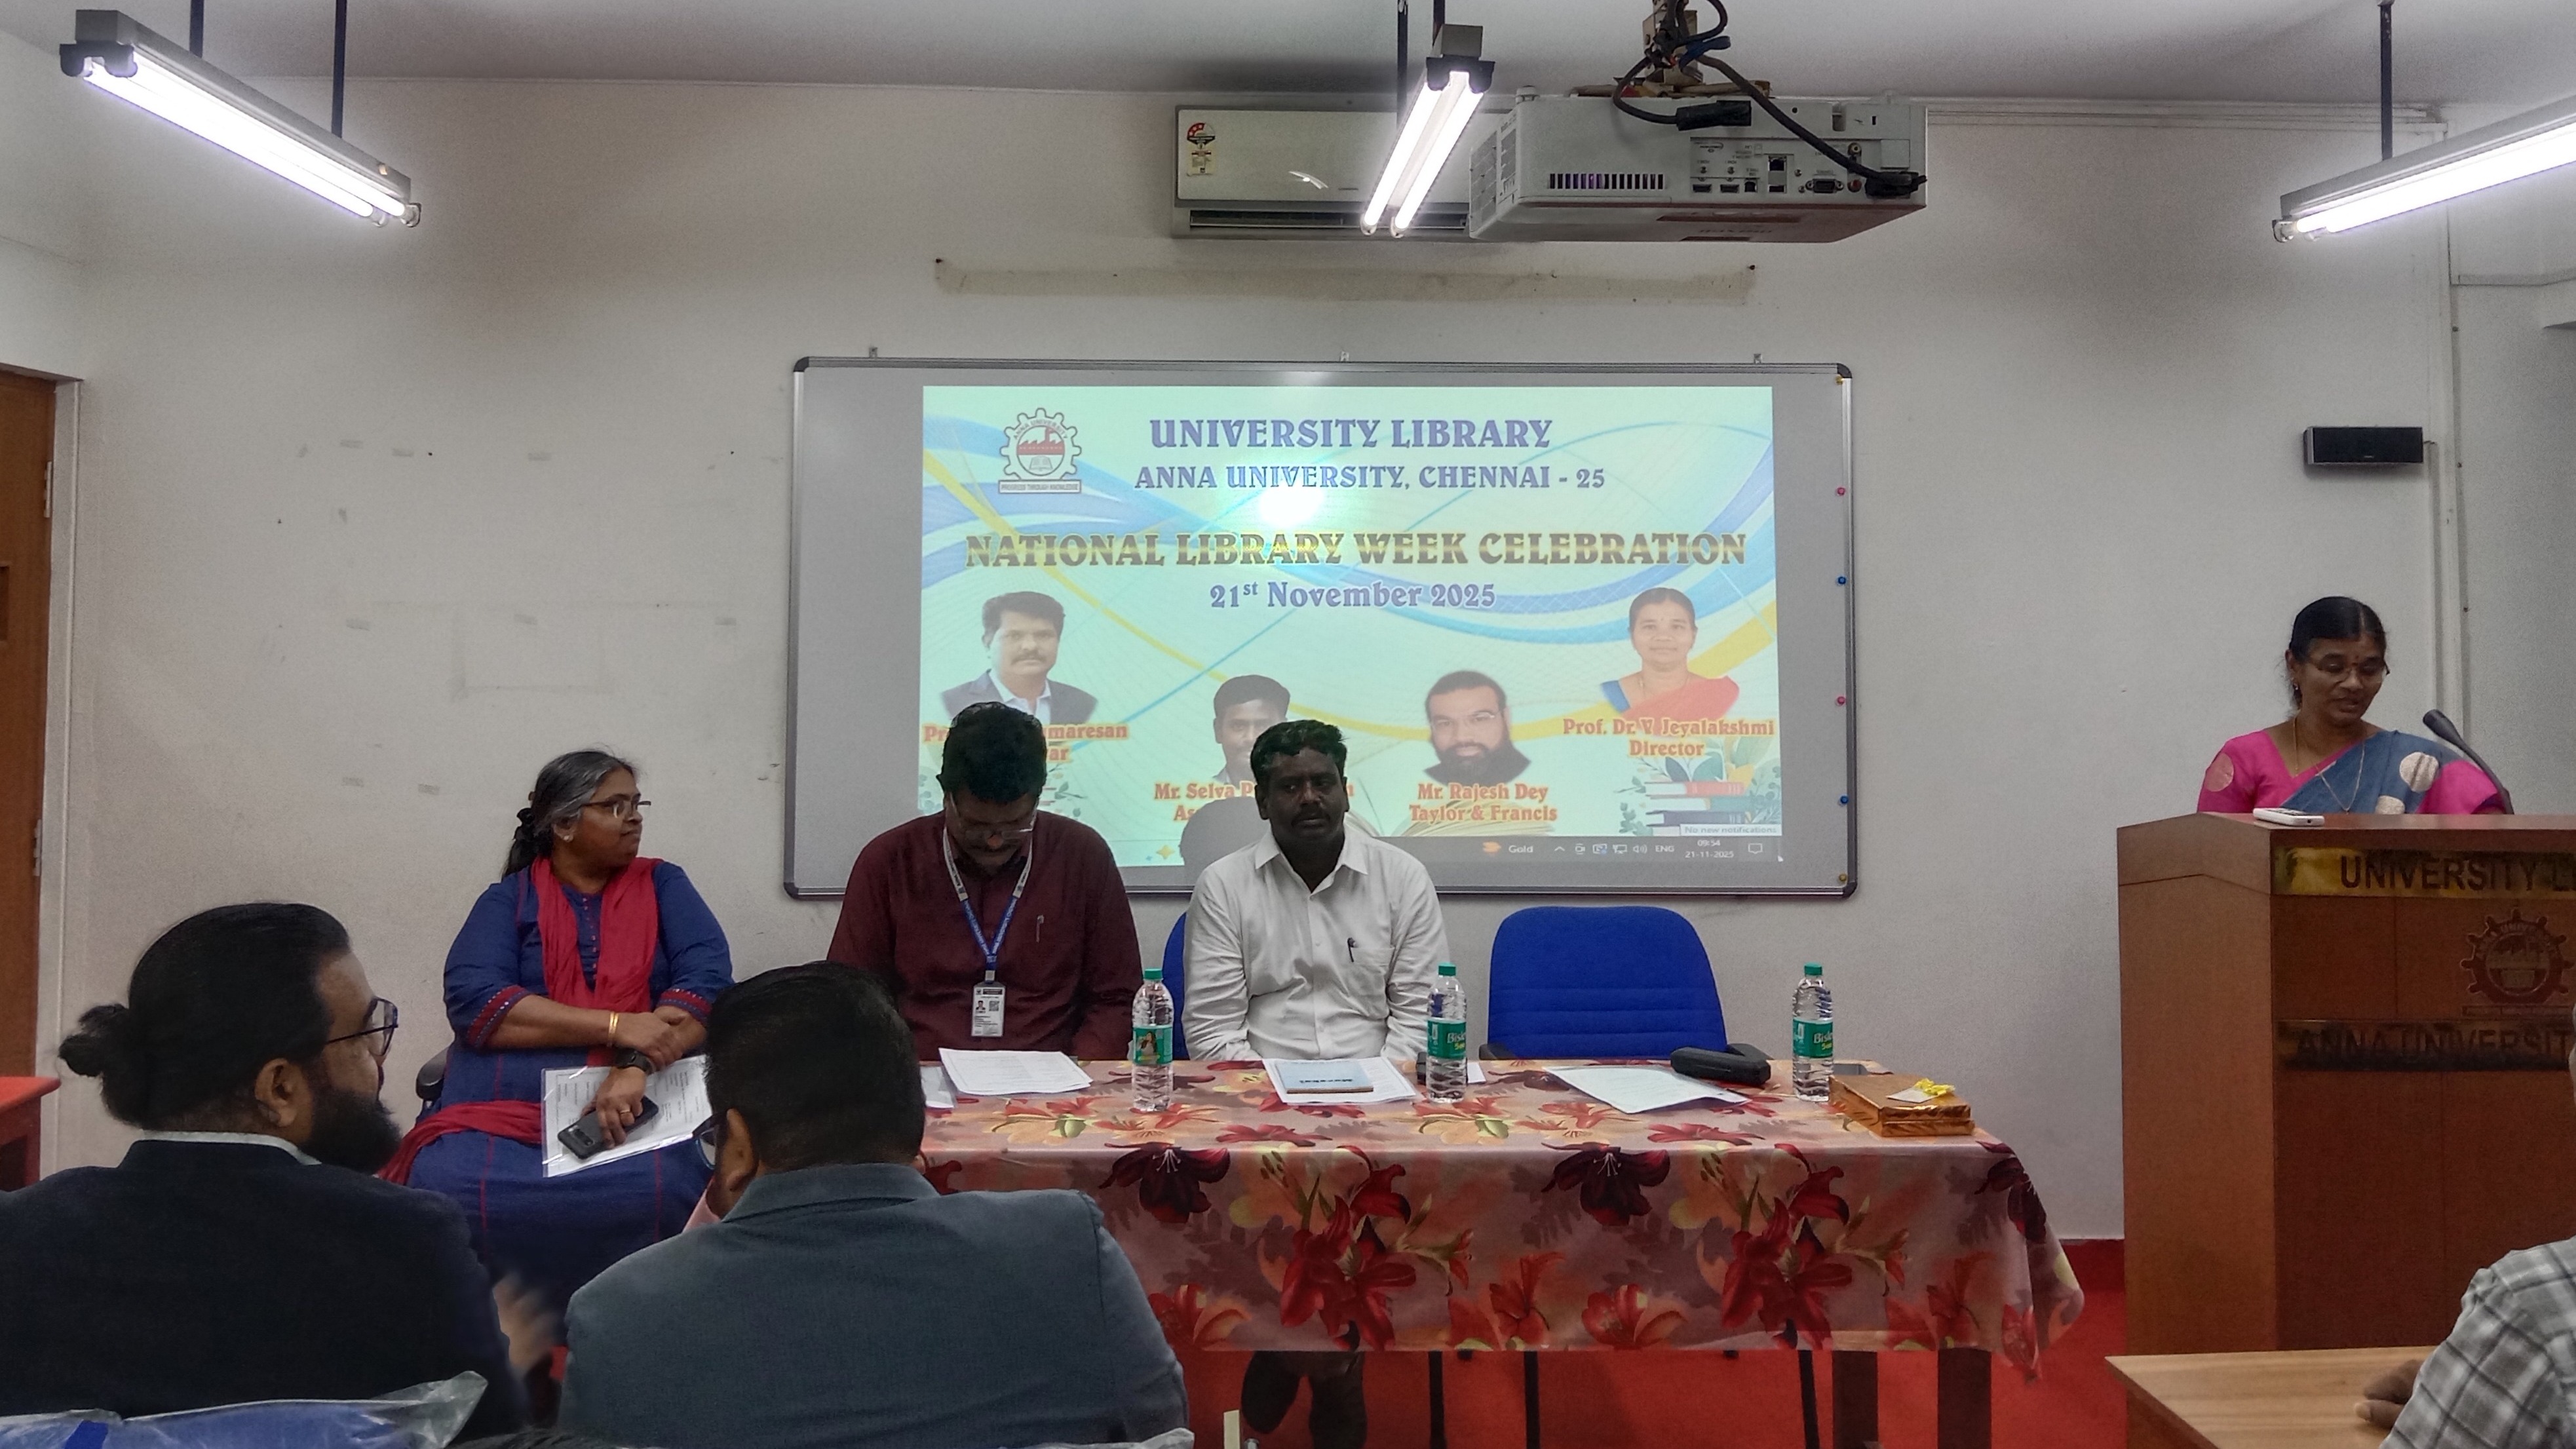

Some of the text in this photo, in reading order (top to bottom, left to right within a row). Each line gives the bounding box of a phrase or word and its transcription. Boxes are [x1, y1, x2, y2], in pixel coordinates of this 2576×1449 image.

[1150, 419, 1552, 449] UNIVERSITY LIBRARY
[1134, 466, 1217, 488] ANNA
[1227, 466, 1411, 490] UNIVERSITY,
[1419, 466, 1550, 488] CHENNAI
[1576, 468, 1605, 489] 25
[965, 532, 1747, 567] NATIONAL LIBRARY WEEK CELEBRATION
[1210, 581, 1496, 608] 21st November 2025
[1043, 725, 1127, 739] maresan
[1563, 719, 1607, 735] Prof.
[1663, 719, 1775, 738] Jeyalakshmi
[1629, 740, 1705, 756] Director
[1186, 783, 1236, 799] Selva
[1417, 783, 1548, 803] Mr. Rajesh Dey
[1409, 804, 1558, 824] Taylor & Francis
[2341, 855, 2537, 891] UNIVERSITY
